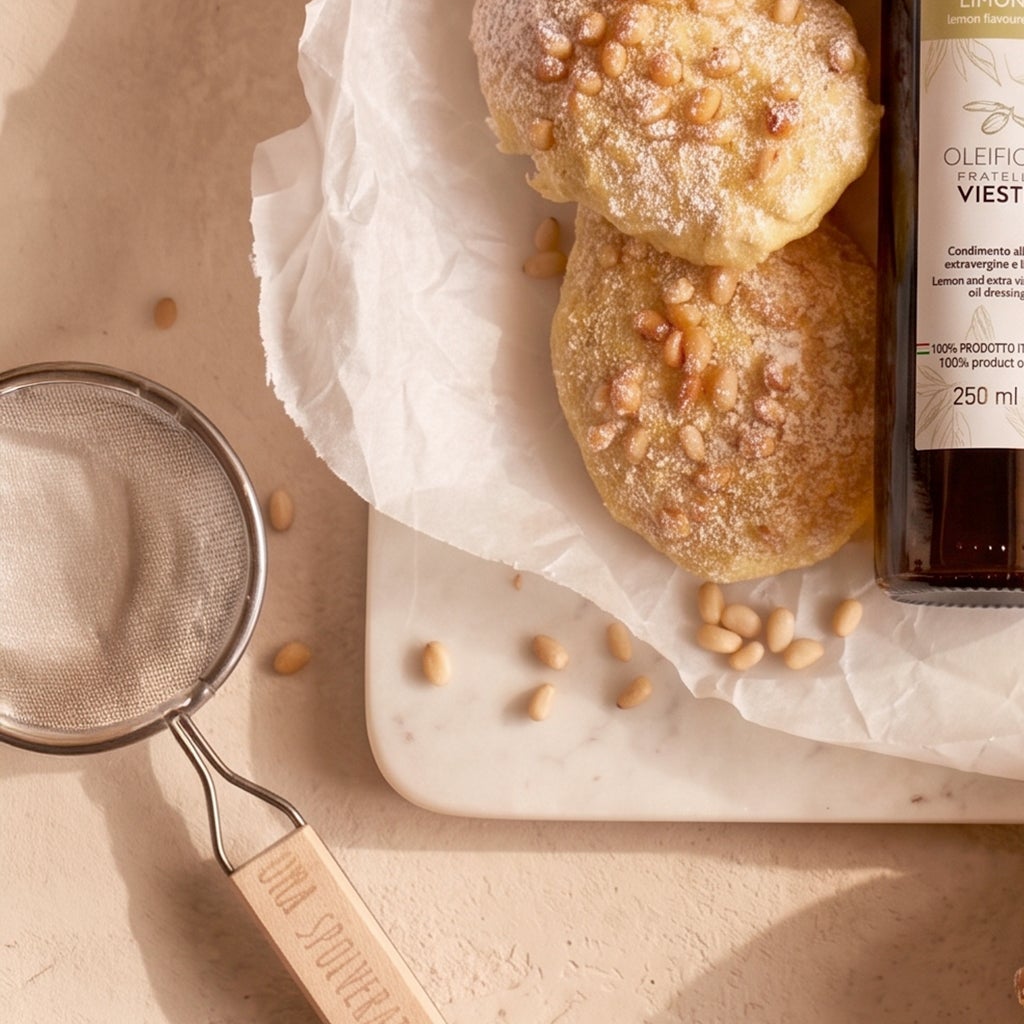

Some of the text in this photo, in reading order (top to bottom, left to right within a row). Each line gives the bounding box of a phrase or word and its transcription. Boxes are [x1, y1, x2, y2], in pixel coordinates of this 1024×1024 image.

[947, 14, 980, 24] lemon
[948, 246, 1011, 256] Condimento
[945, 259, 1009, 271] extravergine
[932, 277, 964, 286] Lemon
[967, 275, 985, 285] and
[987, 277, 1012, 285] extra
[969, 288, 981, 297] oil
[932, 344, 957, 354] 100%
[960, 343, 1014, 353] PRODOTTO
[939, 358, 969, 368] 100%
[972, 358, 1014, 369] product
[953, 387, 988, 405] 250
[995, 387, 1018, 405] ml
[295, 913, 411, 1024] SPOLVERA
